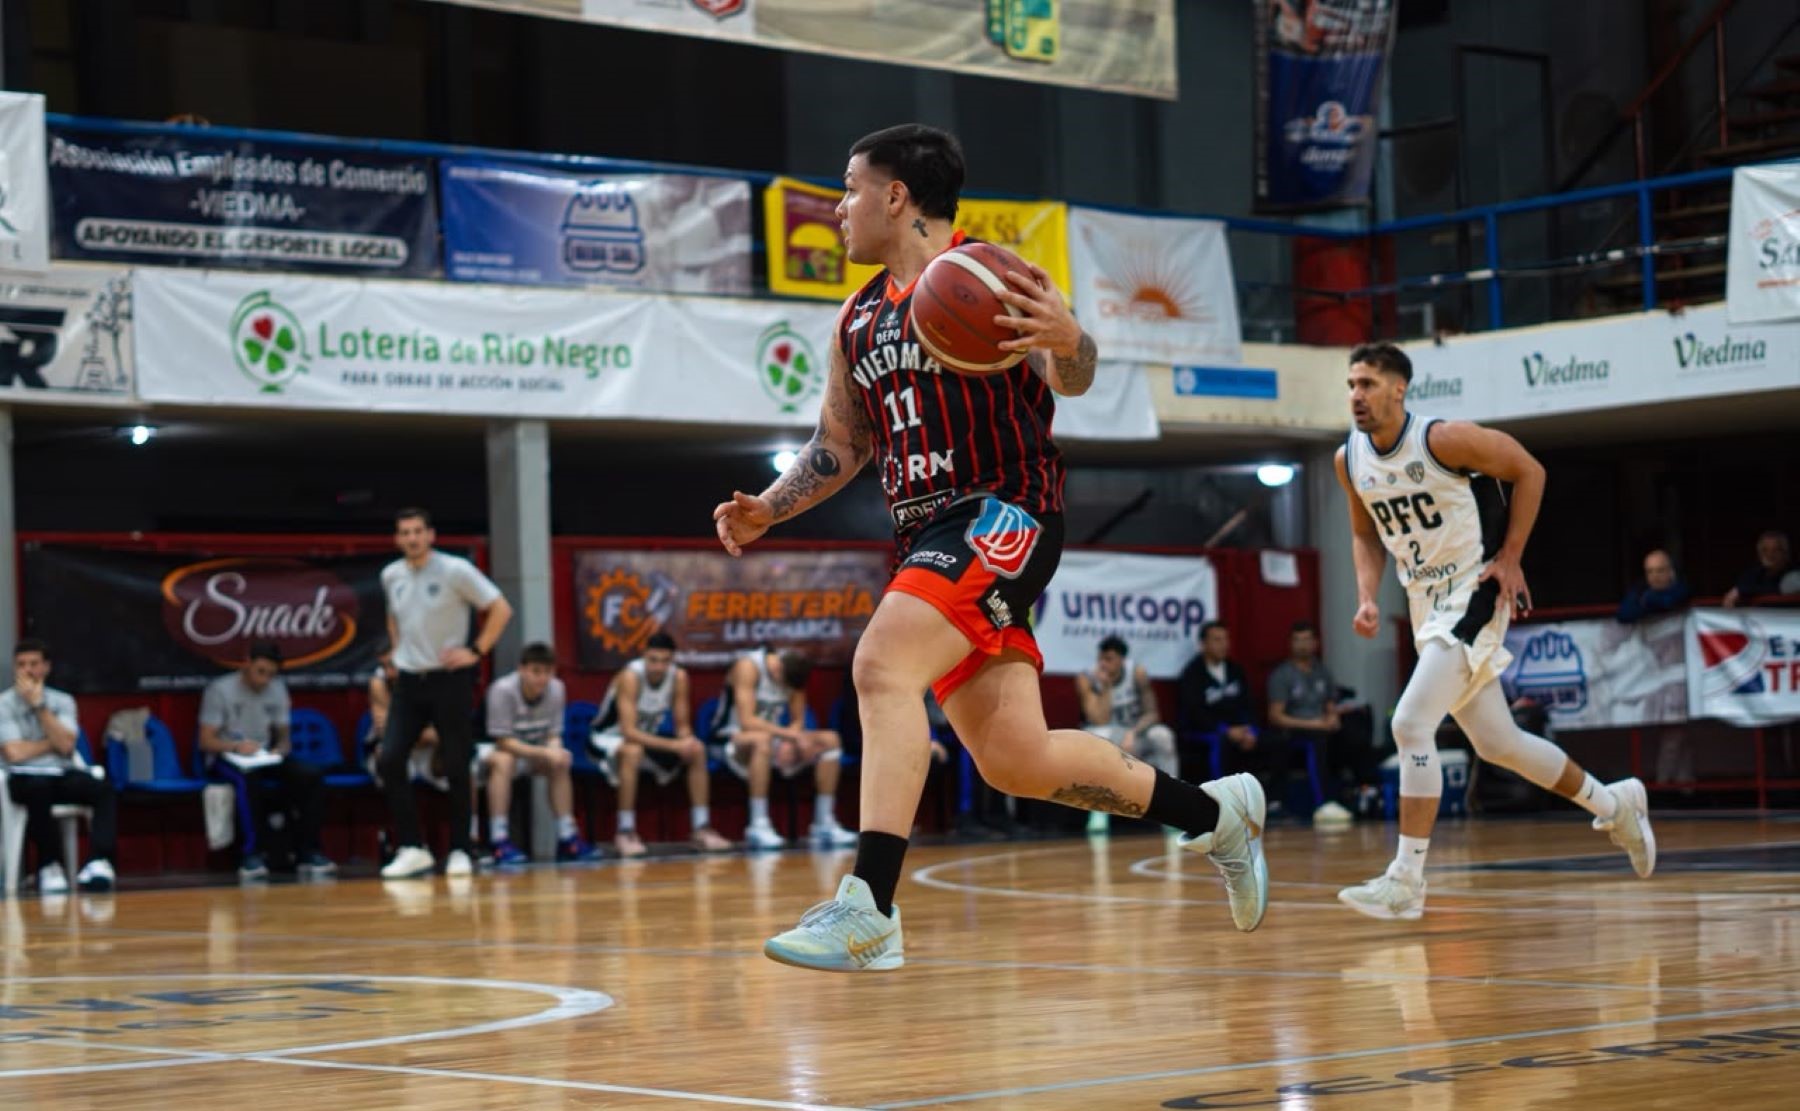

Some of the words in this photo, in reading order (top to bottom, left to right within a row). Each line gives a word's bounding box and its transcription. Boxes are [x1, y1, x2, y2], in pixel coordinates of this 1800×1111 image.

[175, 150, 296, 184] Empleados
[299, 156, 326, 187] de
[329, 159, 427, 195] Comercio
[83, 224, 198, 248] APOYANDO
[203, 231, 228, 250] EL
[238, 232, 334, 255] DEPORTE
[340, 240, 401, 261] LOCAL
[876, 328, 901, 345] DEPO
[1673, 332, 1767, 369] Viedma
[449, 338, 478, 364] de
[543, 335, 632, 380] Negro
[852, 342, 942, 390] VIEDMA
[1522, 352, 1610, 388] Viedma
[1405, 374, 1462, 401] edma
[884, 386, 922, 433] 11
[1371, 492, 1443, 537] PFC
[1409, 540, 1425, 565] 2
[183, 571, 333, 645] Snack
[687, 583, 873, 621] FERRETERÍA
[1062, 590, 1206, 638] unicoop
[724, 620, 748, 642] LA
[753, 619, 843, 642] COMARCA
